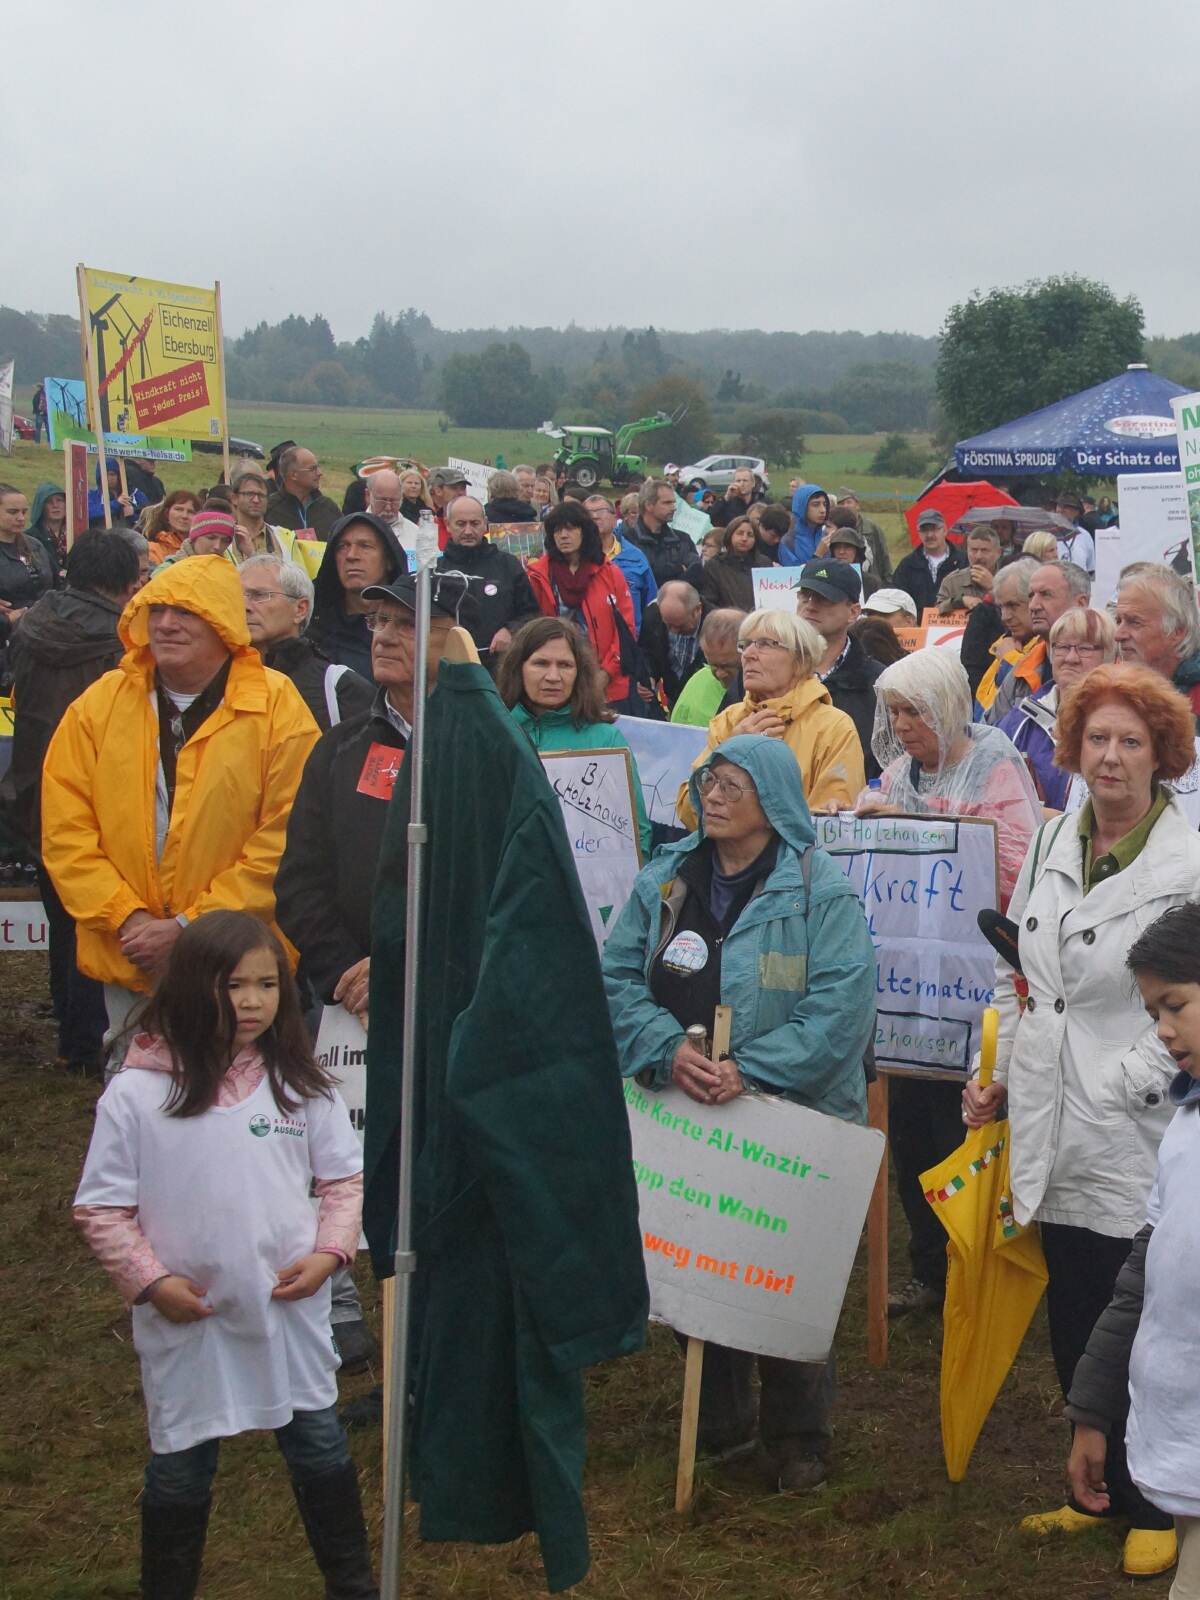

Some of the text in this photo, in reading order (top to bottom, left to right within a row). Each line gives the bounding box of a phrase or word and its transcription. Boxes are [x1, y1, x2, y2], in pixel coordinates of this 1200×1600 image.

[162, 309, 213, 333] Eichenzell
[164, 335, 214, 361] Ebersburg
[134, 371, 202, 403] Windkraft nicht
[138, 388, 204, 418] um jeden Preis!
[963, 450, 1057, 467] FÖRSTINA SPRUDEL
[1077, 451, 1178, 466] Der Schatz der
[759, 577, 793, 591] Nein!
[901, 638, 917, 648] AHN
[575, 831, 610, 853] der
[823, 818, 948, 844] BI-Holzhausen
[843, 852, 966, 911] dkraft
[876, 964, 995, 1004] lternative
[876, 1020, 958, 1053] zhausen
[318, 1046, 339, 1068] rall
[650, 1100, 703, 1141] Karte
[706, 1127, 812, 1179] Al-Wazir
[632, 1159, 789, 1235] opp den Wahn
[643, 1231, 795, 1295] weg mit Dir!
